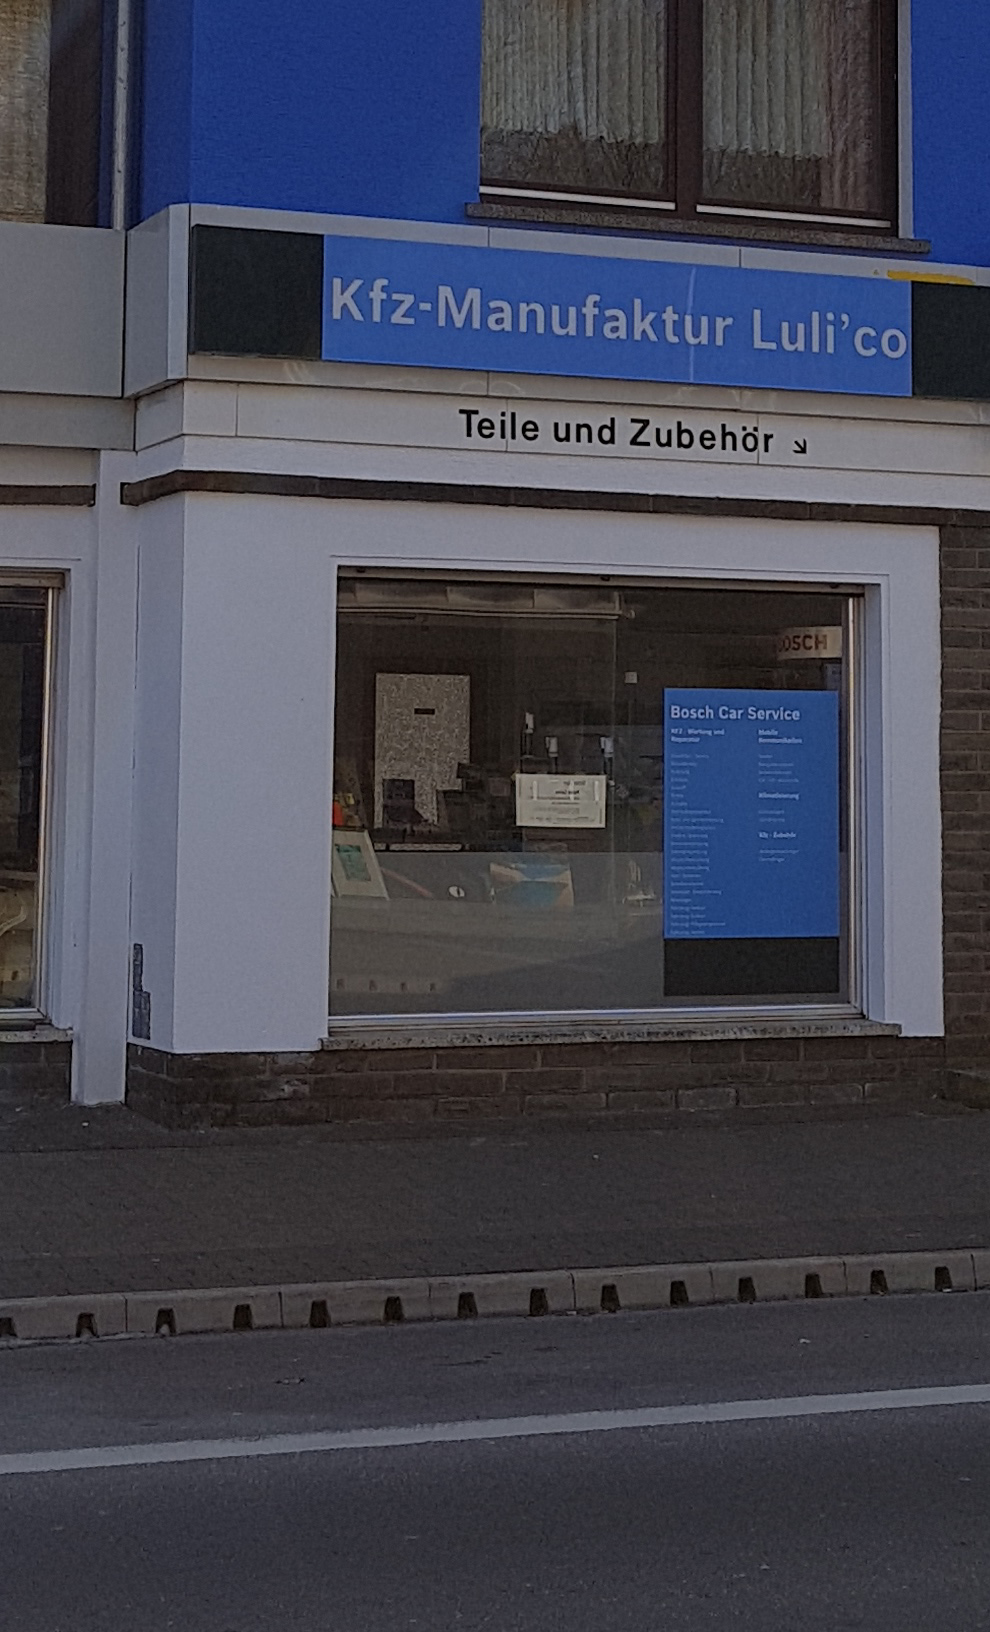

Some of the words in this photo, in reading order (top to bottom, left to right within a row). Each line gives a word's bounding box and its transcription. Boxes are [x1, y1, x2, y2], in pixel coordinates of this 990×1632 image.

[332, 277, 733, 347] Kfz-Manufaktur
[458, 408, 540, 442] Teile
[553, 416, 616, 445] und
[629, 417, 774, 453] Zubehör
[671, 705, 714, 719] Bosch
[718, 706, 744, 720] Car
[747, 706, 801, 721] Service
